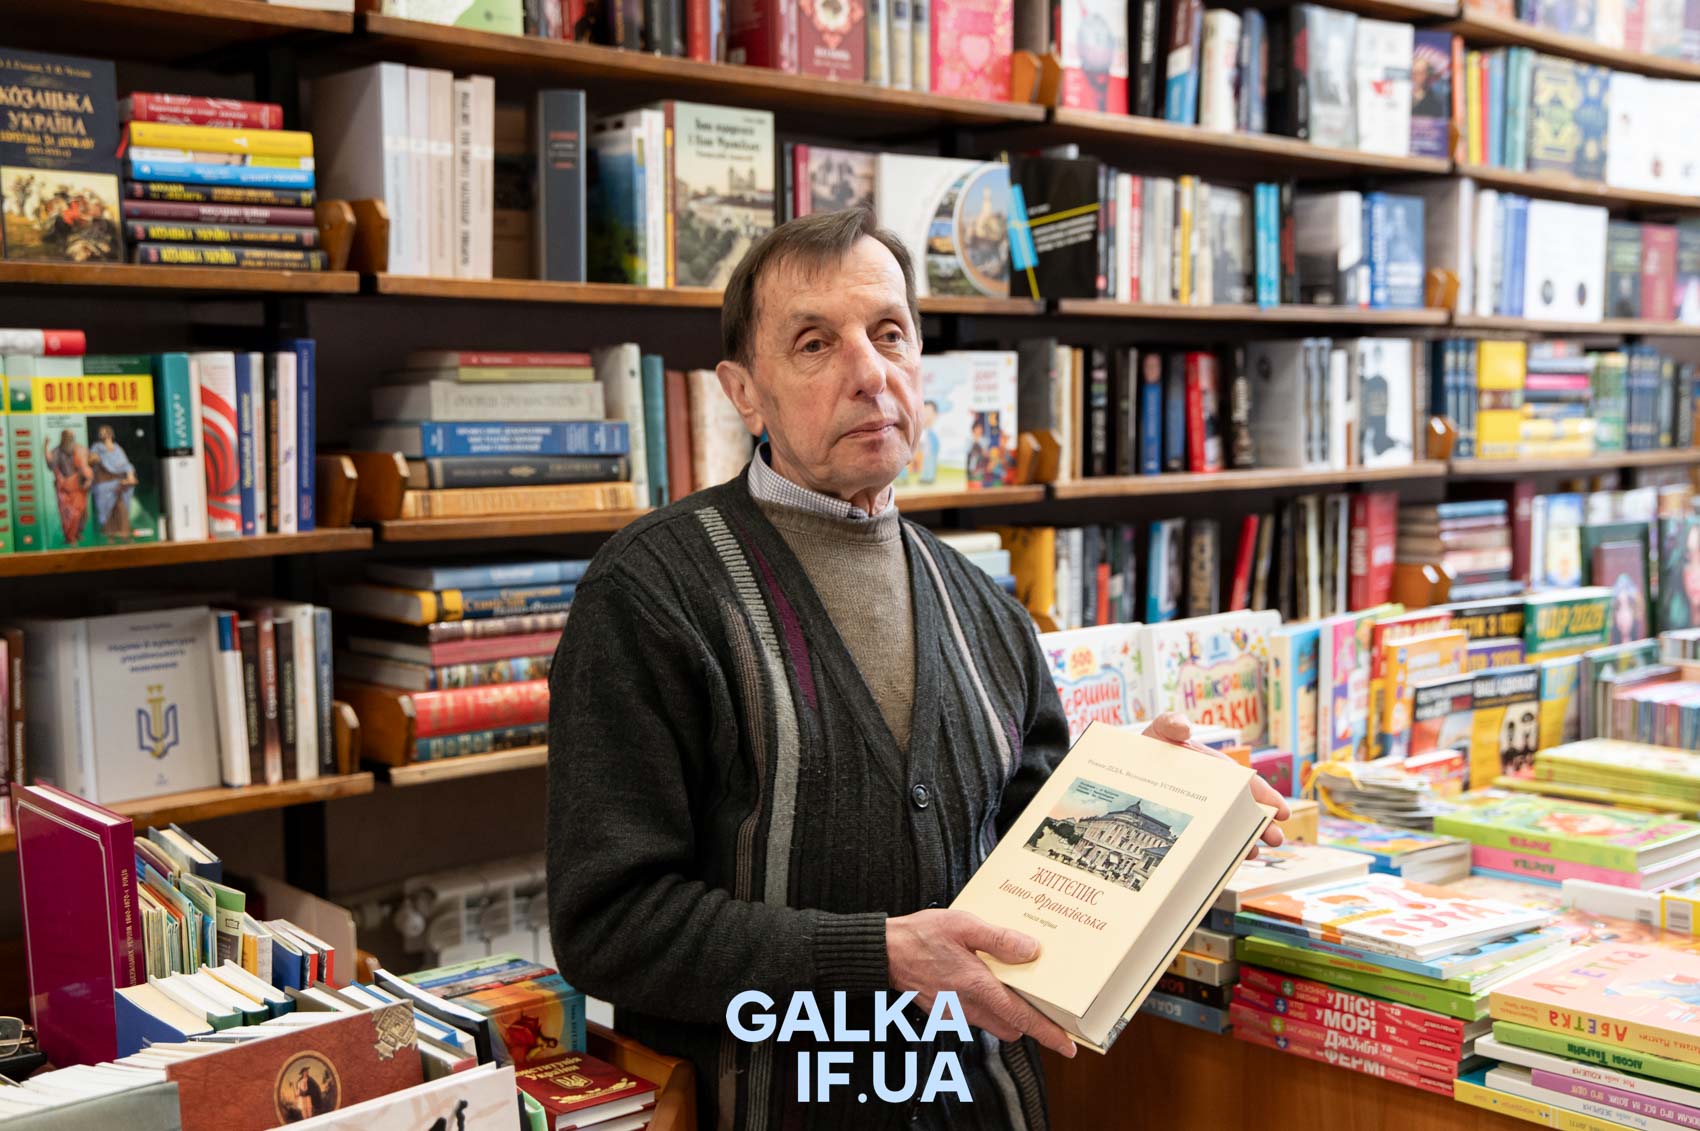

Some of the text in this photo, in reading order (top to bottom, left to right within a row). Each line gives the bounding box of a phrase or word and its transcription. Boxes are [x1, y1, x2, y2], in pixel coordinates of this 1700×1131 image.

[44, 381, 138, 403] ФІЛОСОФІЯ
[121, 868, 129, 887] РОКІВ
[1029, 866, 1105, 906] ЖИТТЄПИС
[998, 879, 1108, 931] Івано-Франківська
[515, 1057, 583, 1078] онституція
